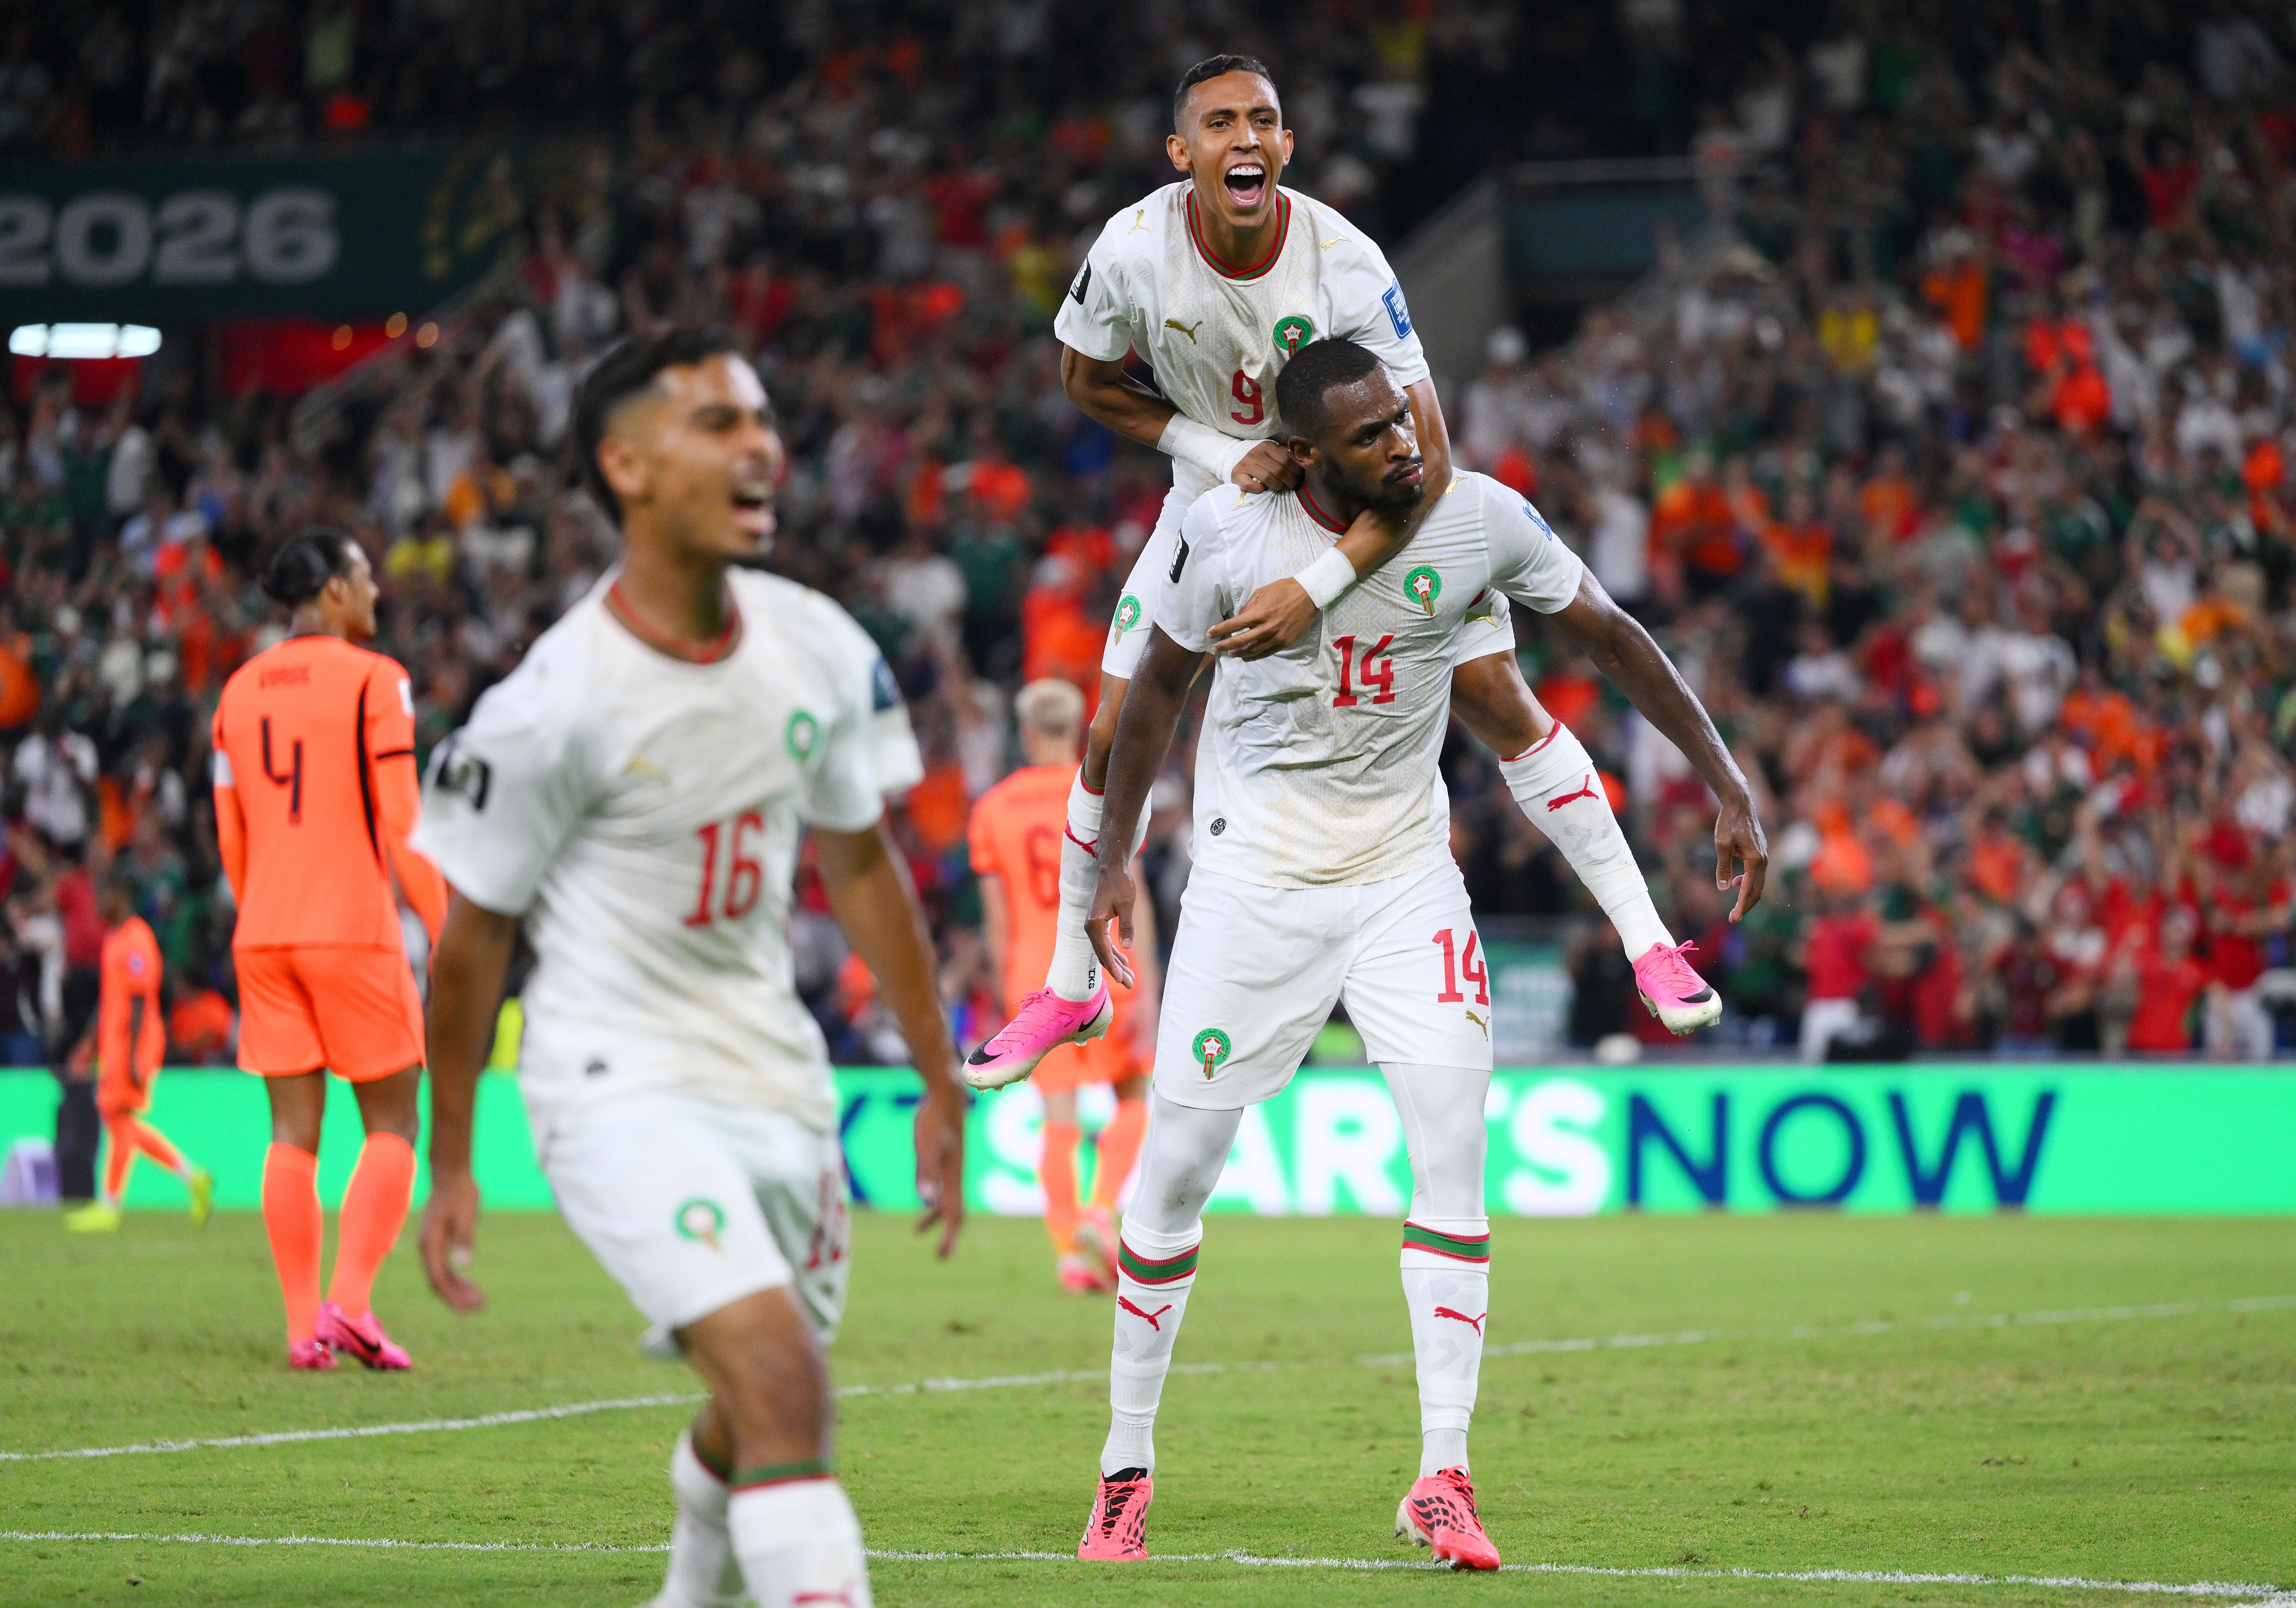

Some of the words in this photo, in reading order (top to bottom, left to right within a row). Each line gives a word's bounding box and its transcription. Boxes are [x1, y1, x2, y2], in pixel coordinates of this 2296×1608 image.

[0, 188, 341, 284] 2026
[1231, 369, 1264, 425] 9
[1333, 635, 1396, 709] 14
[261, 715, 303, 826] 4
[683, 808, 763, 926] 16
[1432, 928, 1489, 1007] 14
[1629, 1091, 2057, 1207] NOW
